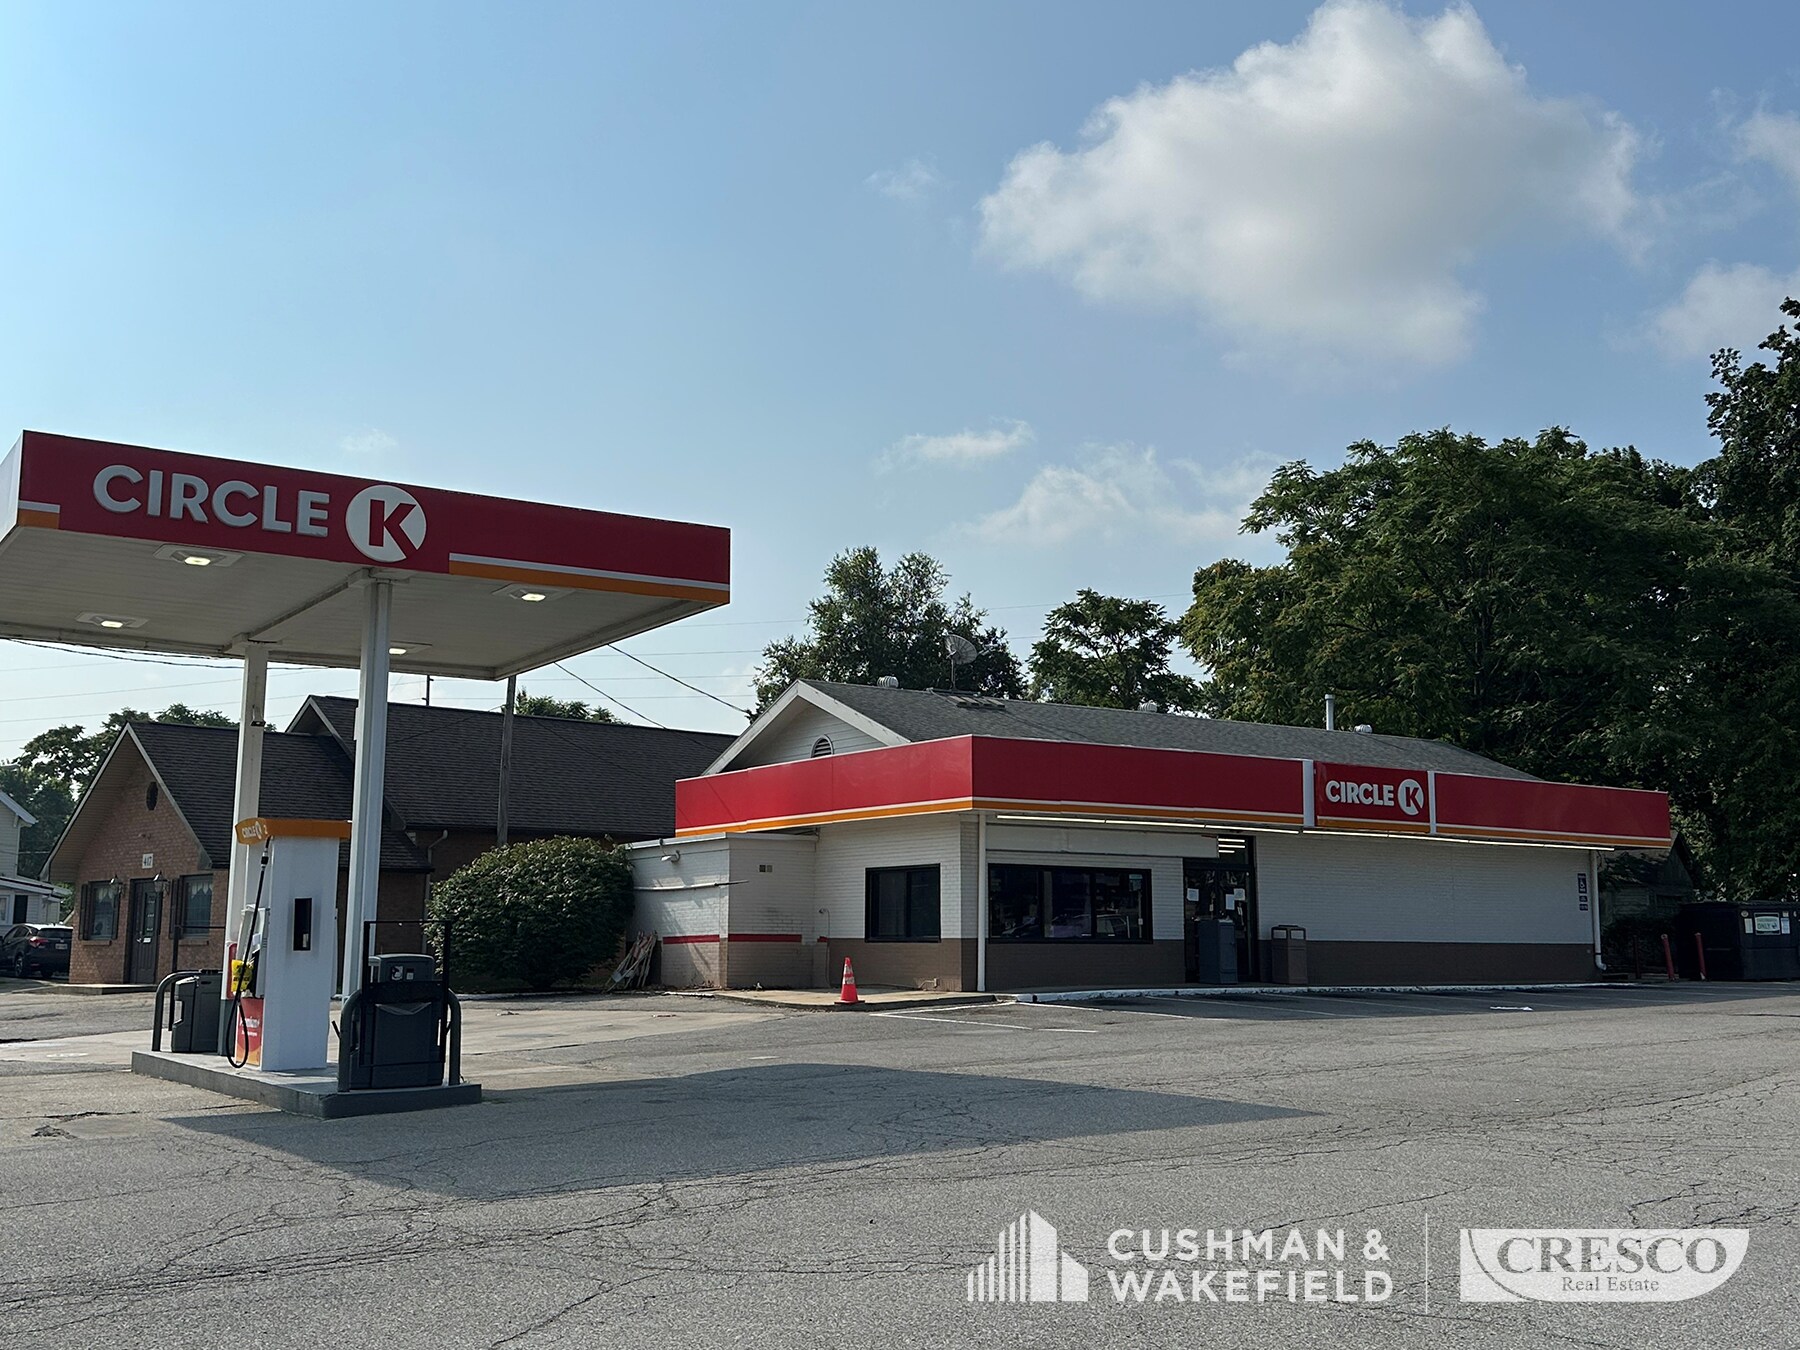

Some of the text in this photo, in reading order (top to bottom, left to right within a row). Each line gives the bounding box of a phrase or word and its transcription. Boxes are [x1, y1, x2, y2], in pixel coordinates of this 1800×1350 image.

[93, 464, 423, 561] CIRCLE K
[1325, 780, 1424, 815] CIRCLE K
[241, 825, 257, 838] CIRCLE
